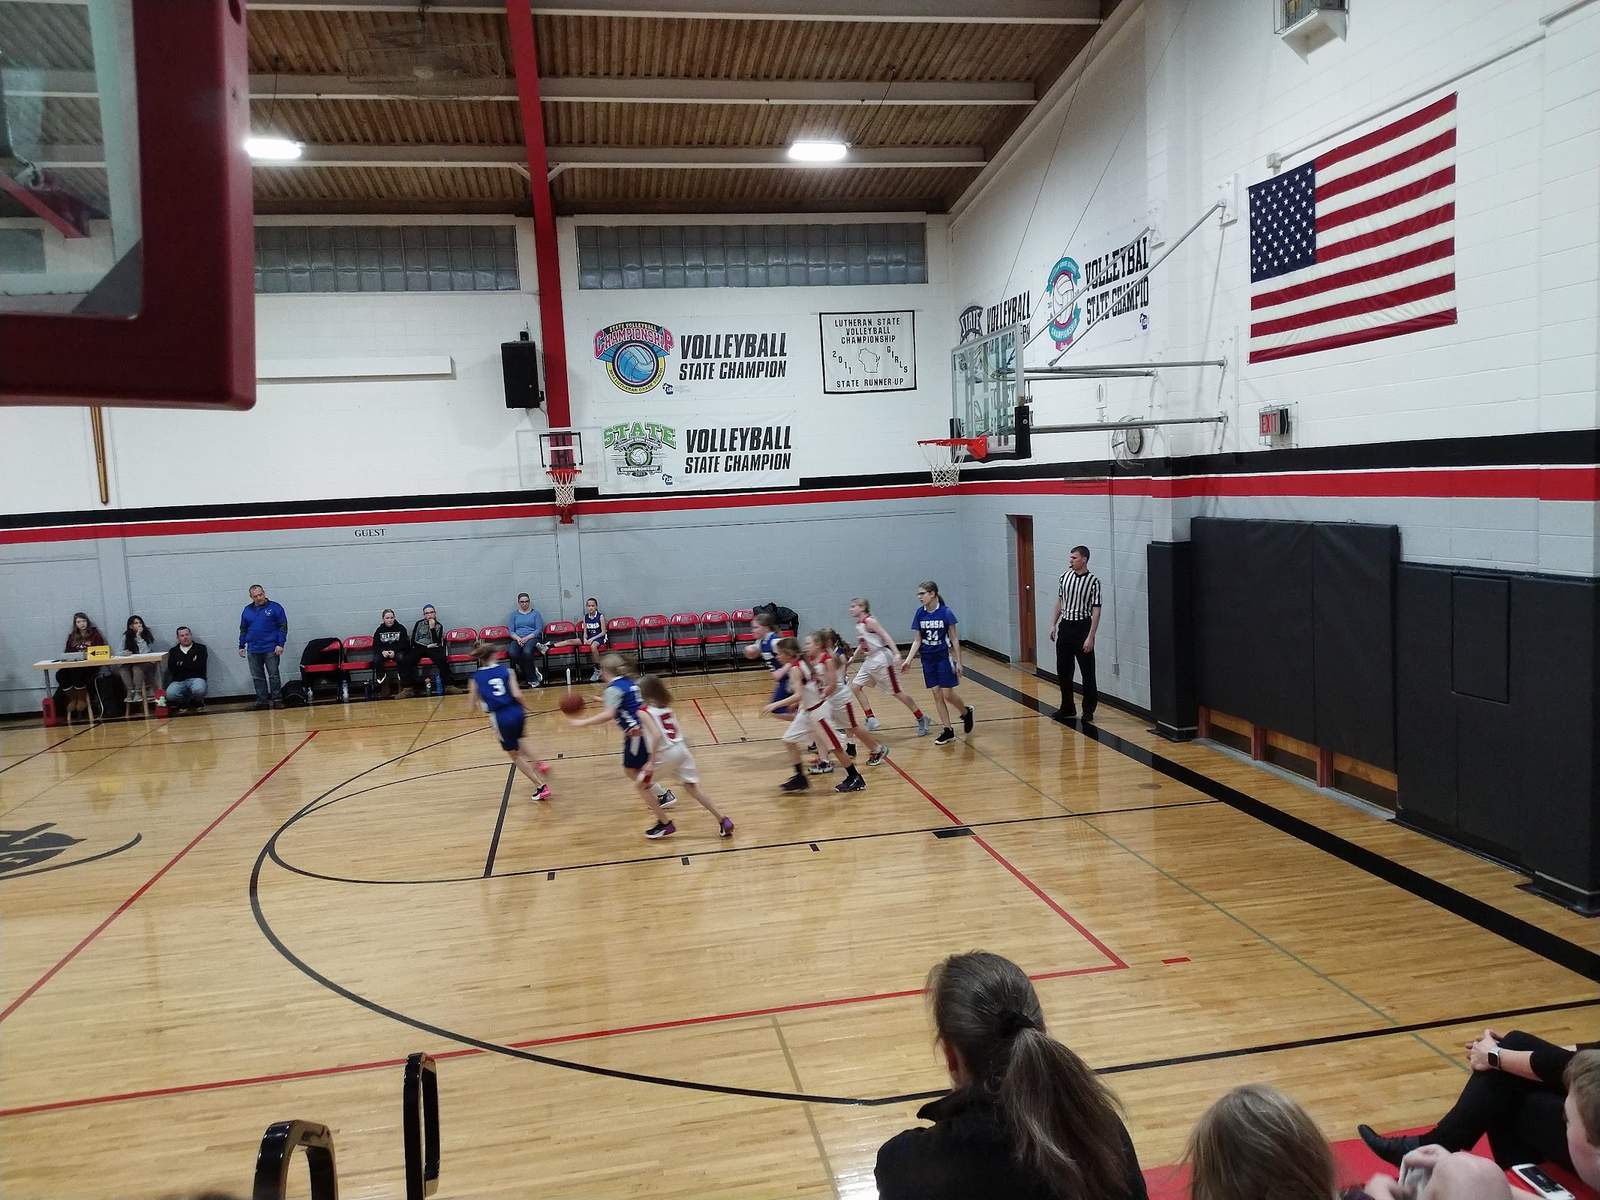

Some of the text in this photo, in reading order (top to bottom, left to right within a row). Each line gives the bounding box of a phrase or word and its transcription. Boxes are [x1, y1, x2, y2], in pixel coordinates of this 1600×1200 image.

[1085, 237, 1149, 291] VOLLEYBAL
[1086, 291, 1110, 325] STATE
[1112, 275, 1149, 317] CHAMPIO
[834, 317, 900, 327] LUTHERAN STATE
[987, 290, 1030, 334] VOLLEYBALL
[609, 322, 657, 332] STATE VOLLEYBALL
[846, 326, 891, 336] VOLLEYBALL
[594, 327, 674, 358] CHAMPIONSHIP
[680, 333, 787, 359] VOLLEYBALL
[841, 335, 896, 344] CHAMPIONSHIP
[832, 350, 852, 374] 2011
[886, 345, 908, 373] GIRLS
[679, 360, 787, 381] STATE CHAMPION
[836, 377, 904, 388] STATE RUNNER-UP
[1260, 412, 1280, 434] EXIT
[603, 421, 677, 449] STATE
[686, 425, 791, 453] VOLLEYBALL
[685, 453, 791, 474] STATE CHAMPION
[354, 528, 387, 538] GUEST
[925, 630, 939, 641] 34
[487, 677, 507, 696] 3
[660, 711, 678, 740] 5
